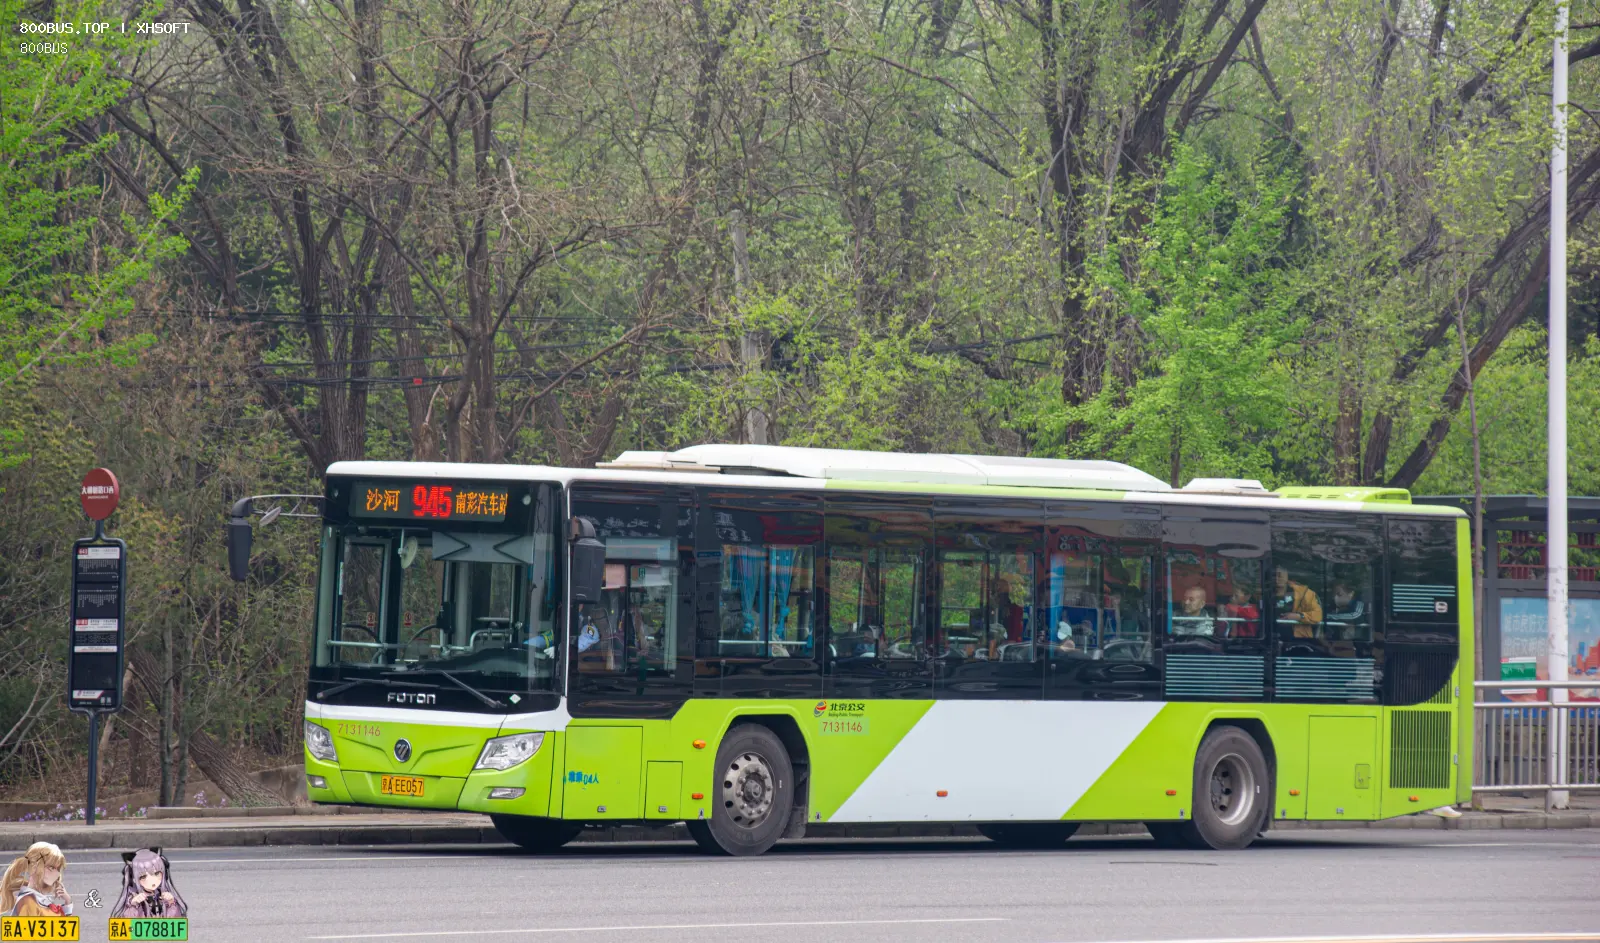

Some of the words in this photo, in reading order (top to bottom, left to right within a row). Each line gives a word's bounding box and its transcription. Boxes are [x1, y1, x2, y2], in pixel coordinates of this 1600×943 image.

[365, 488, 400, 512] 沙河
[413, 485, 452, 519] 945
[387, 691, 436, 705] FOTON
[830, 703, 866, 711] 北京公交
[338, 723, 381, 737] 7131146
[822, 721, 862, 733] 7131146
